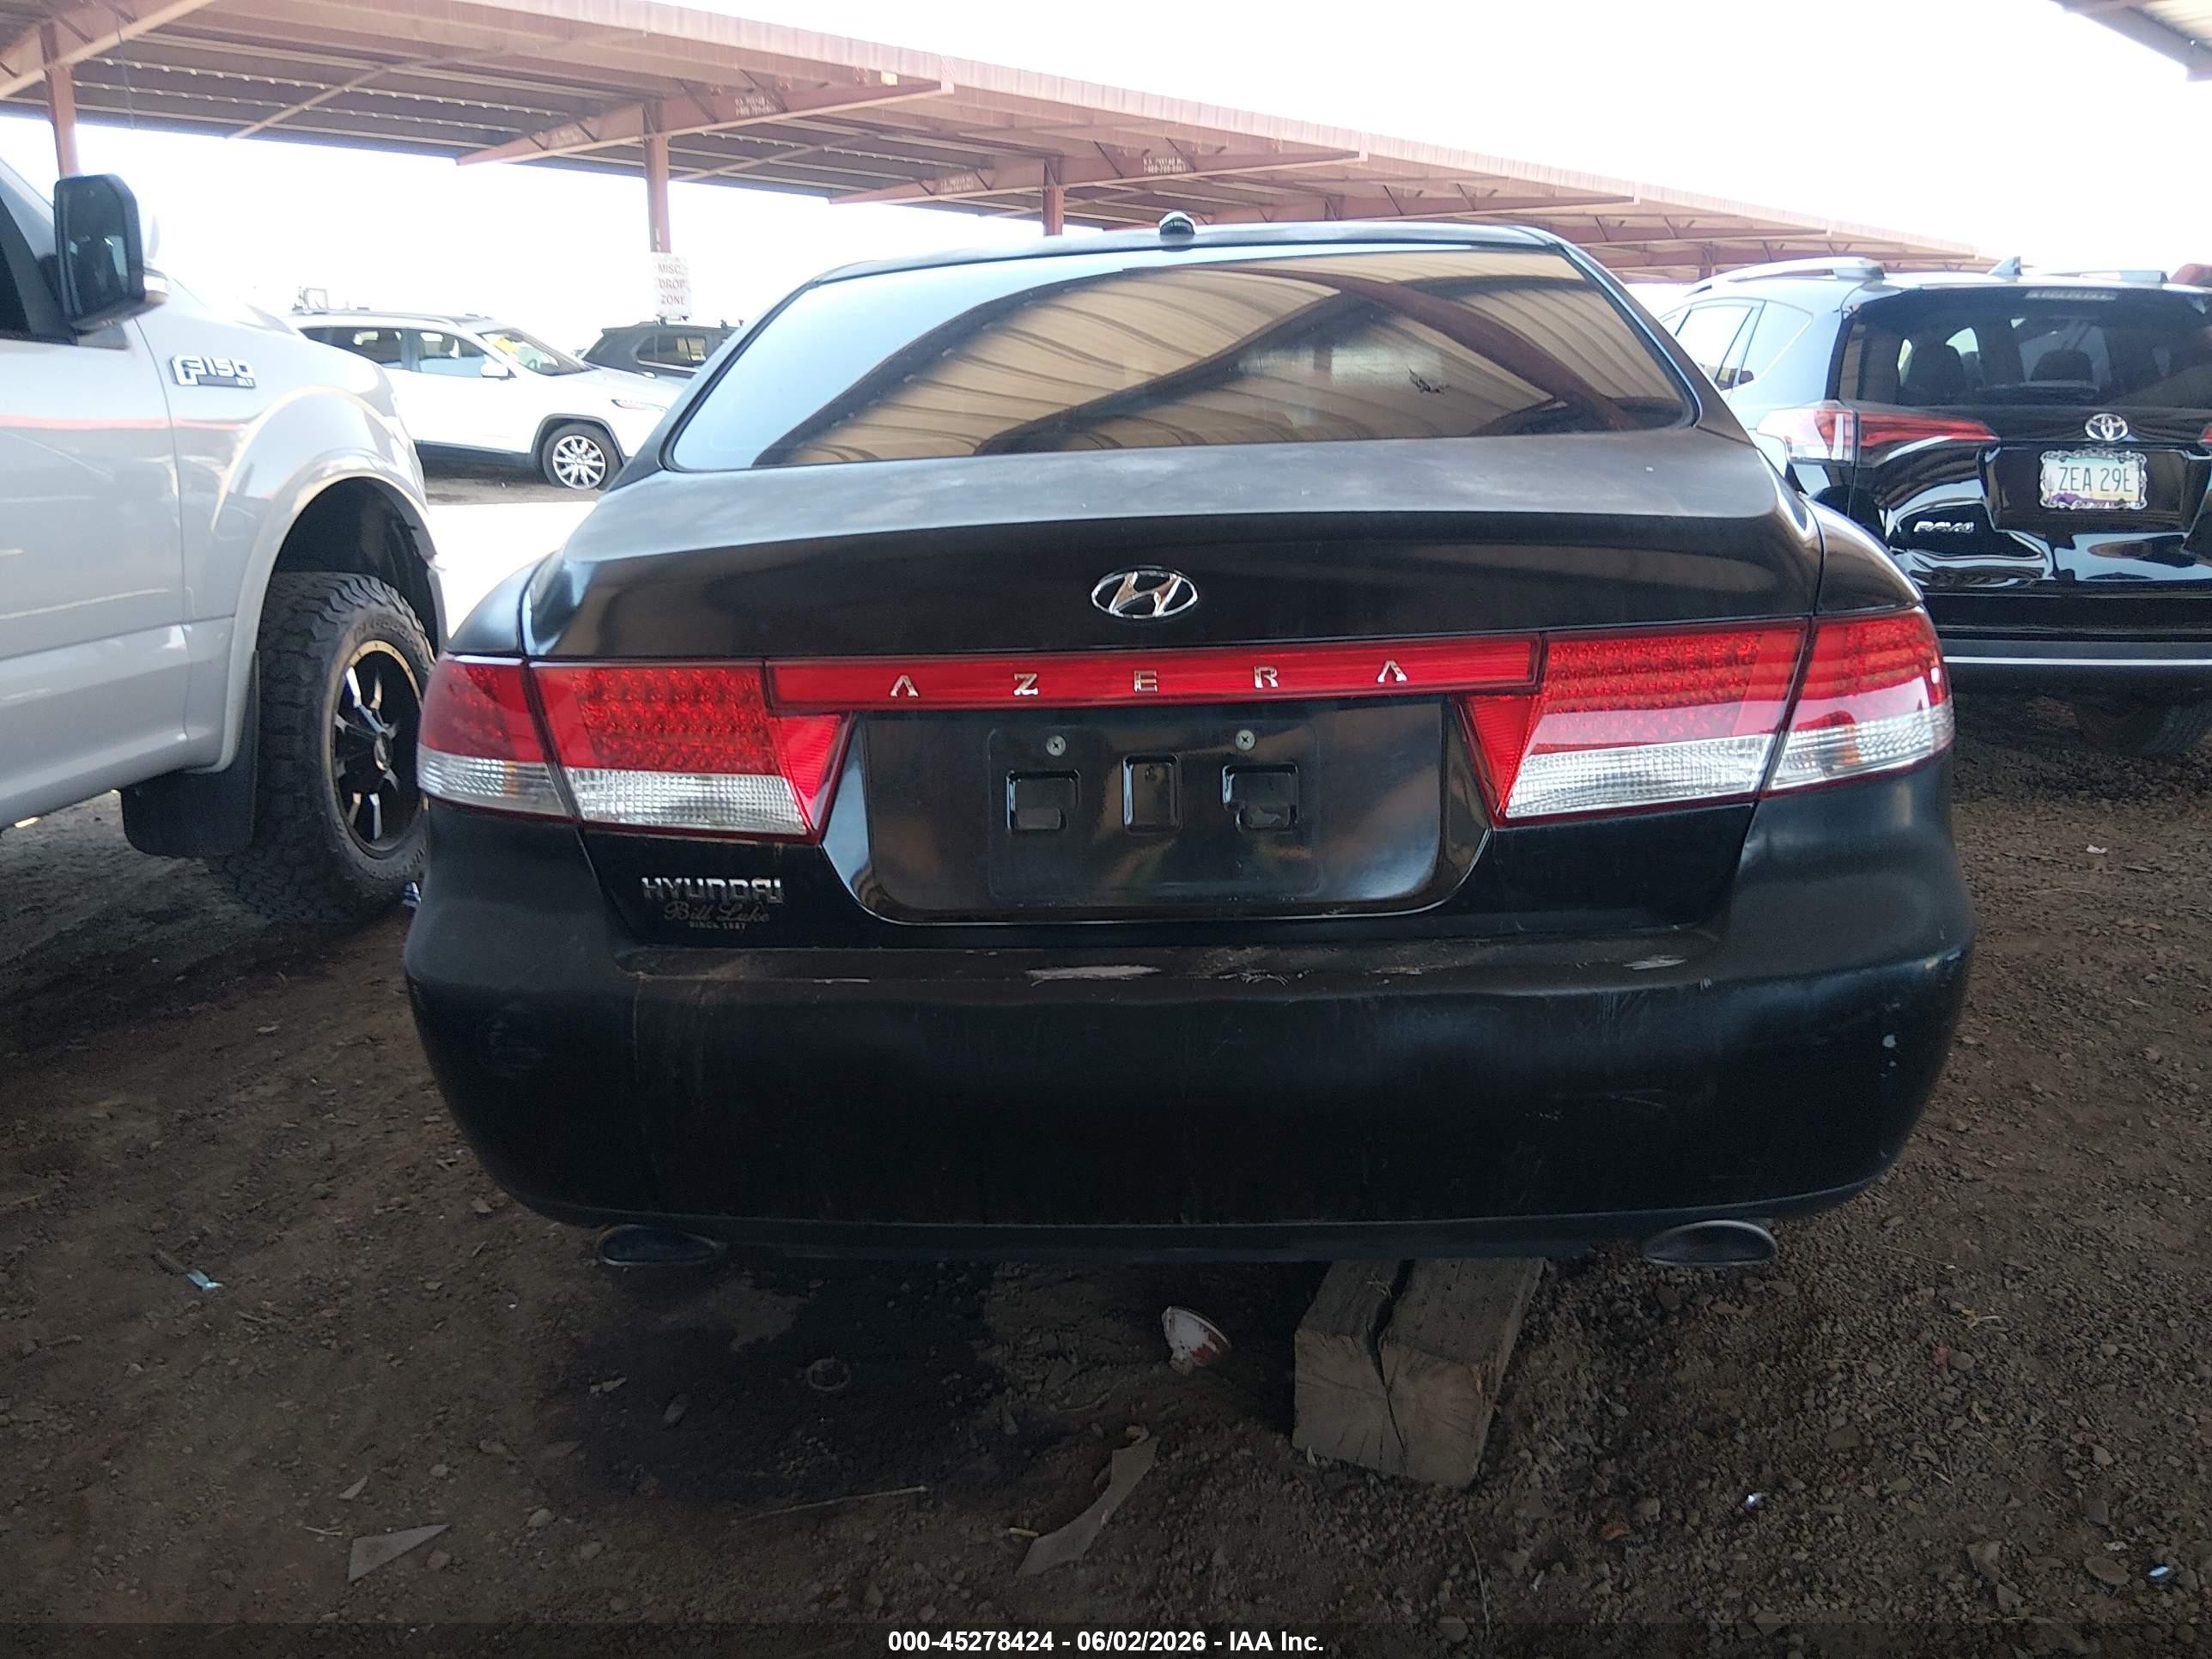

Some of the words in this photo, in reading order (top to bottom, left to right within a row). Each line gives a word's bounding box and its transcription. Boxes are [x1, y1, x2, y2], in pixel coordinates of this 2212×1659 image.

[2058, 466, 2094, 492] ZEA
[2100, 467, 2134, 493] 29E
[1913, 520, 1974, 533] RAV4
[890, 659, 1408, 698] AZERA
[641, 877, 783, 902] HYUNDAI
[665, 901, 715, 921] Bill
